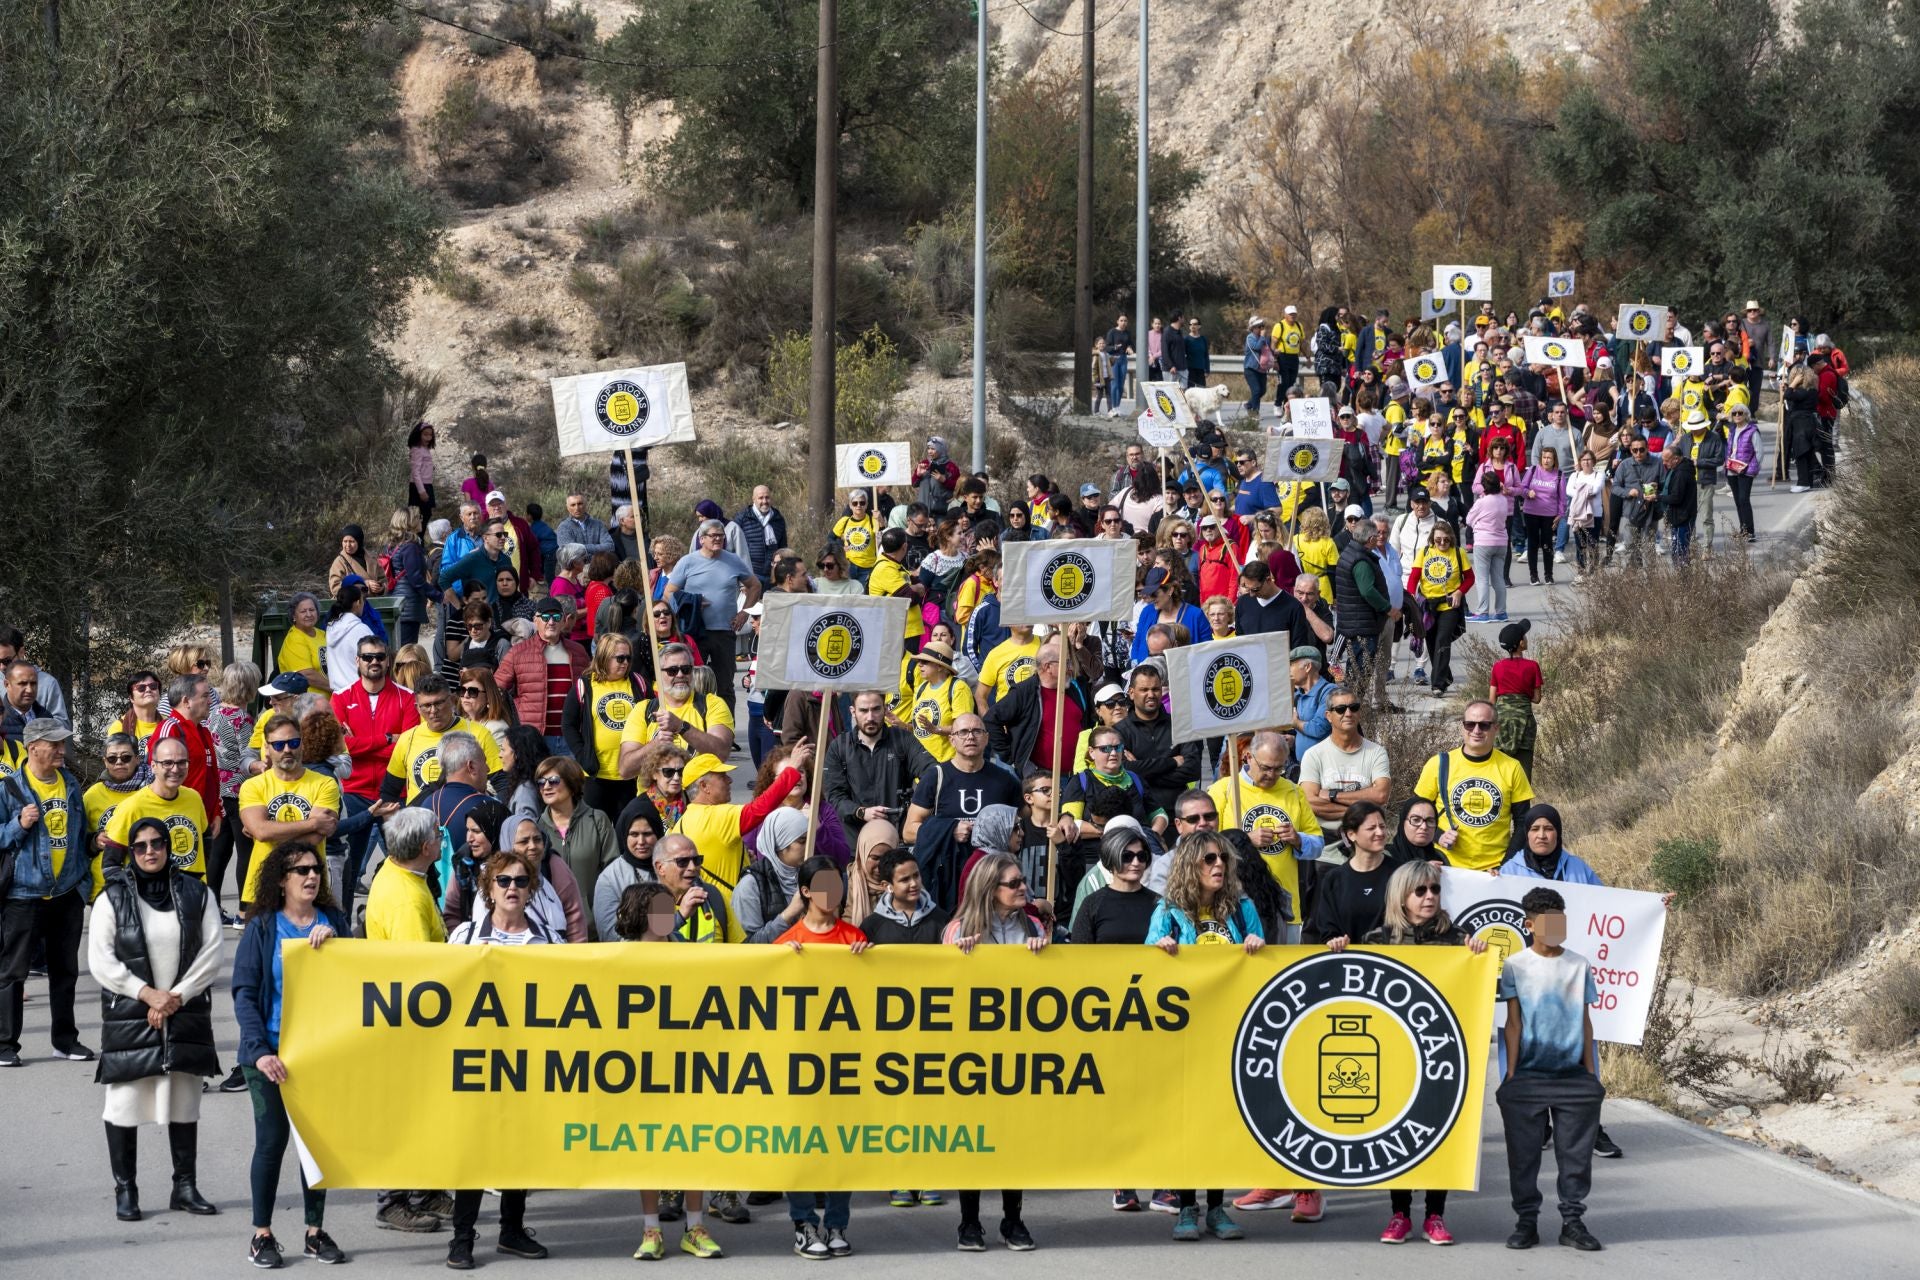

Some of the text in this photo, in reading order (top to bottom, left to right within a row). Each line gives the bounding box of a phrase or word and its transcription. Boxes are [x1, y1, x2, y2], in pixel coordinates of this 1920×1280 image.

[598, 389, 611, 414] STOP
[608, 417, 645, 433] MOLINA
[1044, 560, 1060, 586] STOP
[1050, 592, 1088, 608] MOLINA
[808, 619, 828, 648] STOP
[813, 659, 854, 676] MOLINA
[1206, 663, 1219, 693] STOP
[1213, 698, 1247, 717] MOLINA
[414, 753, 429, 775] STOP
[1454, 783, 1468, 805] STOP
[1245, 810, 1257, 832] STOP
[1459, 811, 1495, 825] MOLINA
[1587, 912, 1625, 940] NO
[1597, 943, 1609, 961] a
[362, 974, 1191, 1033] NO A LA PLANTA DE BIOGÁS
[1245, 979, 1307, 1079] STOP
[1341, 964, 1456, 1082] BIOGÁS
[452, 1048, 1105, 1096] EN MOLINA DE SEGURA
[563, 1122, 996, 1155] PLATAFORMA VECINAL
[1272, 1118, 1436, 1174] MOLINA
